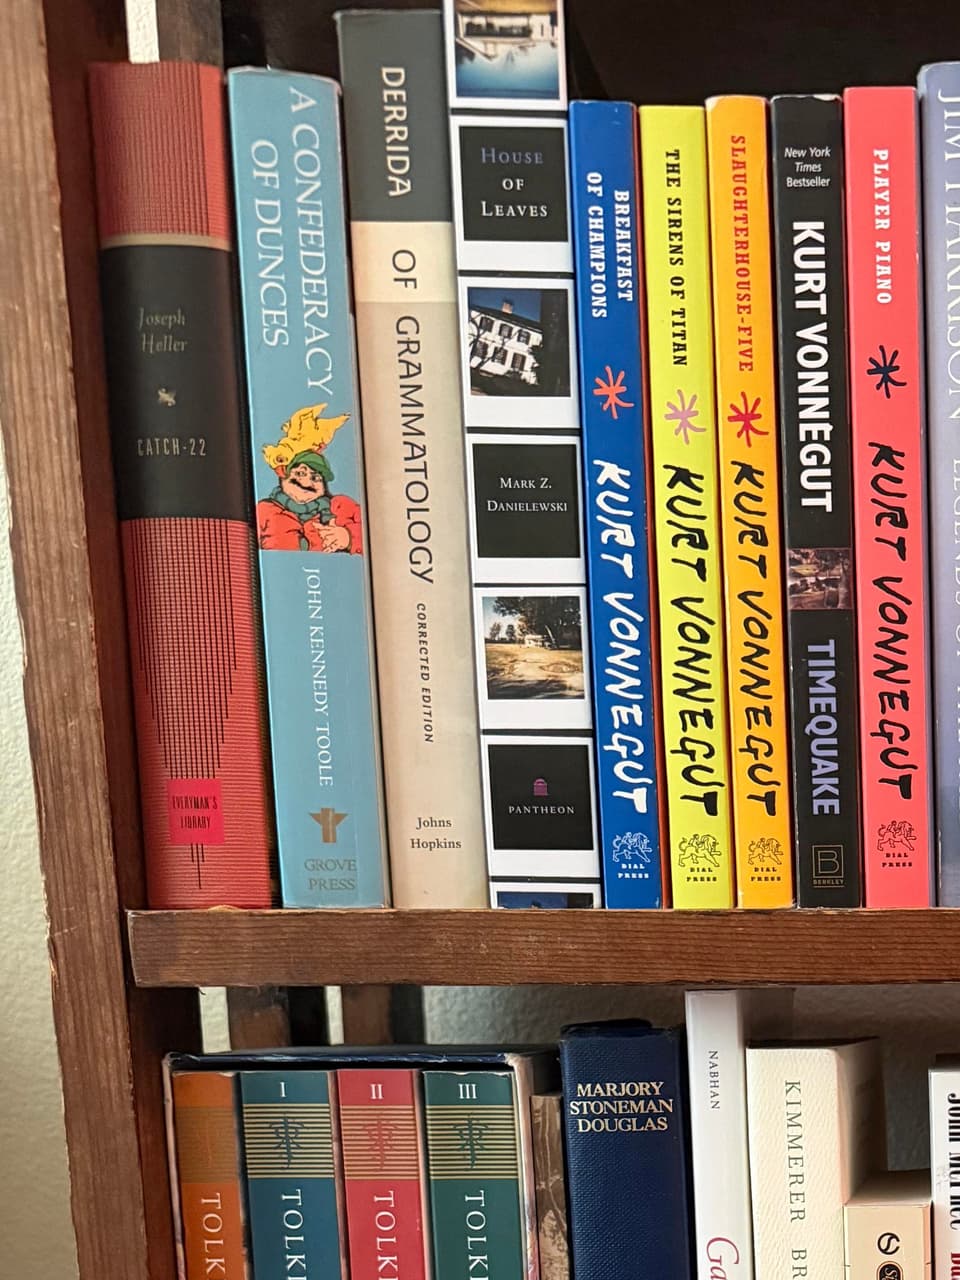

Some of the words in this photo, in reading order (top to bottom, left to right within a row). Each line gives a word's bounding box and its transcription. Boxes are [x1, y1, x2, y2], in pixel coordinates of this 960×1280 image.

[289, 86, 317, 113] A
[381, 65, 413, 198] DERRIDA
[251, 138, 280, 188] OF
[784, 147, 806, 158] New
[809, 146, 831, 159] York
[795, 162, 822, 173] Times
[586, 171, 602, 197] OF
[786, 176, 831, 188] Bestseller
[290, 123, 334, 397] CONFEDERACY
[588, 205, 607, 318] CHAMPIONS
[614, 189, 633, 301] BREAKFAST
[731, 135, 754, 373] SLAUGHTERHOUSE-FIVE
[254, 199, 289, 348] DUNCES
[392, 248, 417, 290] OF
[792, 221, 827, 315] KURT
[137, 307, 186, 330] Joseph
[141, 334, 188, 353] Heller
[795, 323, 834, 513] VONNEGUT
[137, 437, 207, 457] CATCH-22
[395, 314, 434, 585] GRAMMATOLOGY
[806, 639, 840, 816] TIMEQUAKE
[508, 805, 575, 815] PANTHEON
[280, 1082, 286, 1097] I
[577, 1082, 665, 1097] MARJORY
[569, 1099, 673, 1115] STONEMAN
[577, 1117, 668, 1133] DOUGLAS
[784, 1080, 807, 1223] KIMMERER
